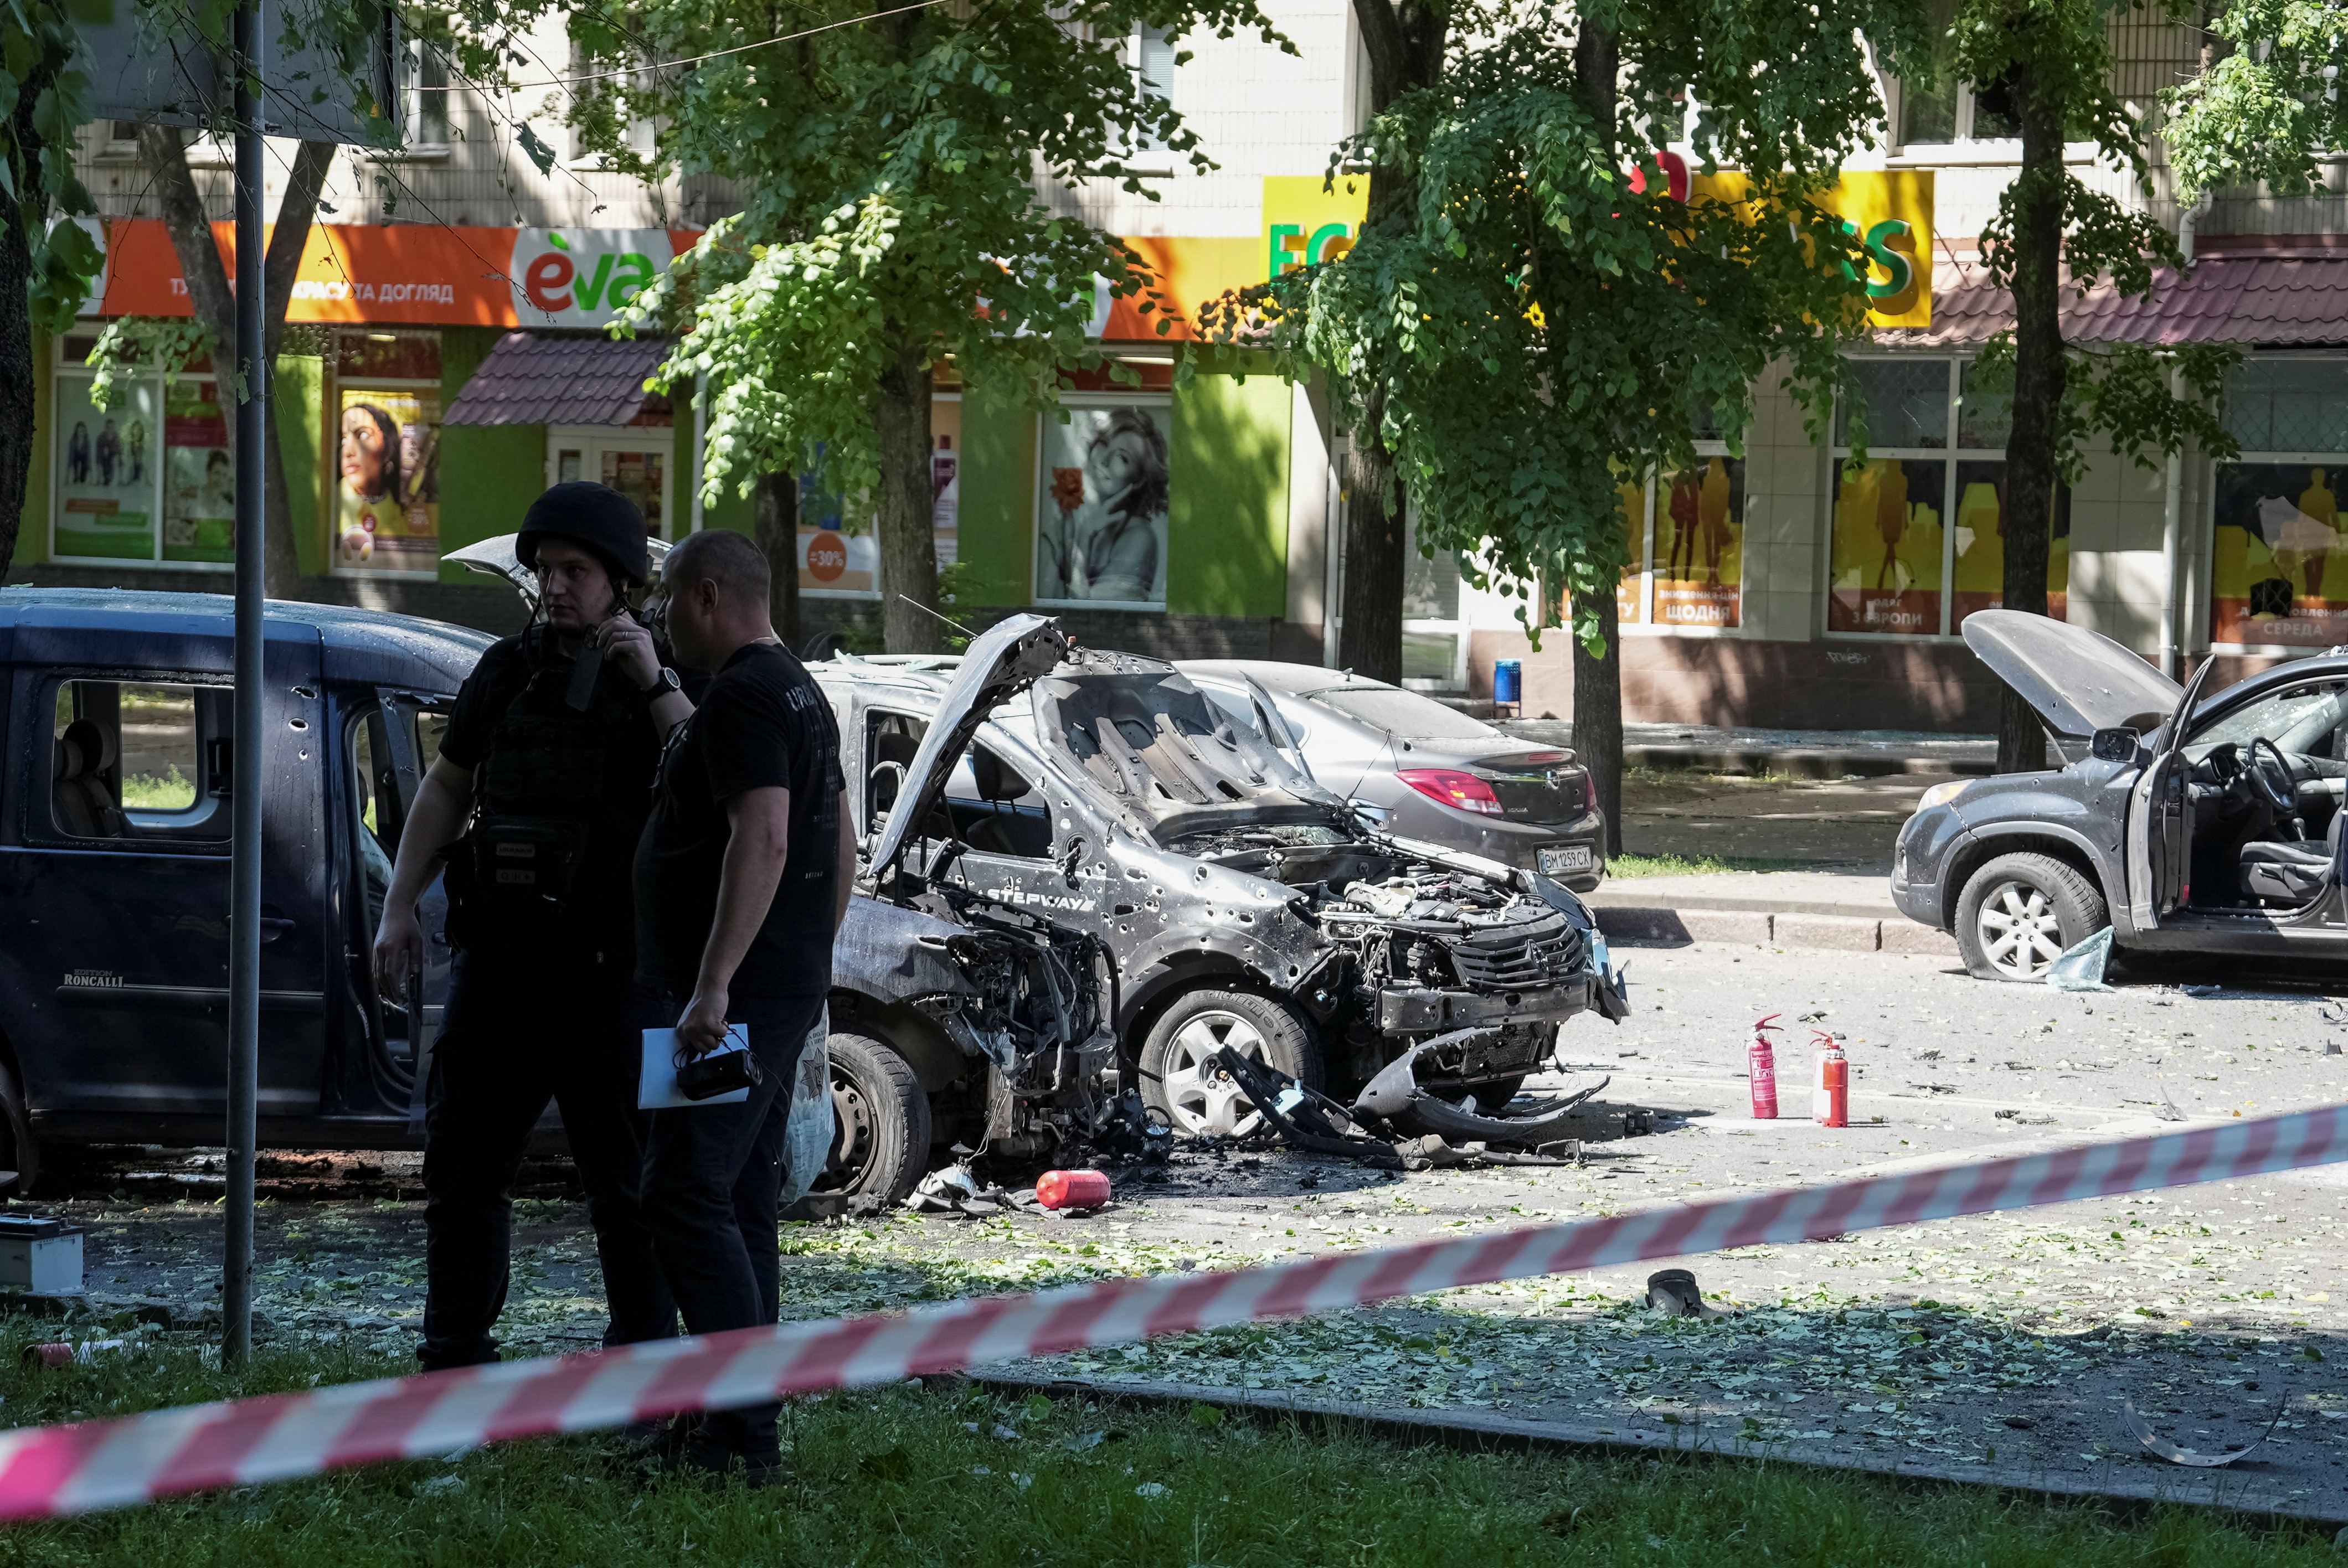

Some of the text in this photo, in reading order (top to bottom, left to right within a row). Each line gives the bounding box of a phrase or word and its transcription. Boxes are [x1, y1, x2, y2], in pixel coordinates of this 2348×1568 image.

[526, 233, 656, 312] eva
[290, 281, 454, 304] КРАСУ ТА ДОГЛЯД
[1666, 604, 1731, 621] ЩОДНЯ
[2263, 622, 2324, 637] СЕРЕДА
[1545, 850, 1589, 868] BM 1259 CX
[987, 888, 1084, 911] STEPWAY
[64, 973, 123, 988] RONCALLI
[1208, 991, 1264, 1019] MICHELIN
